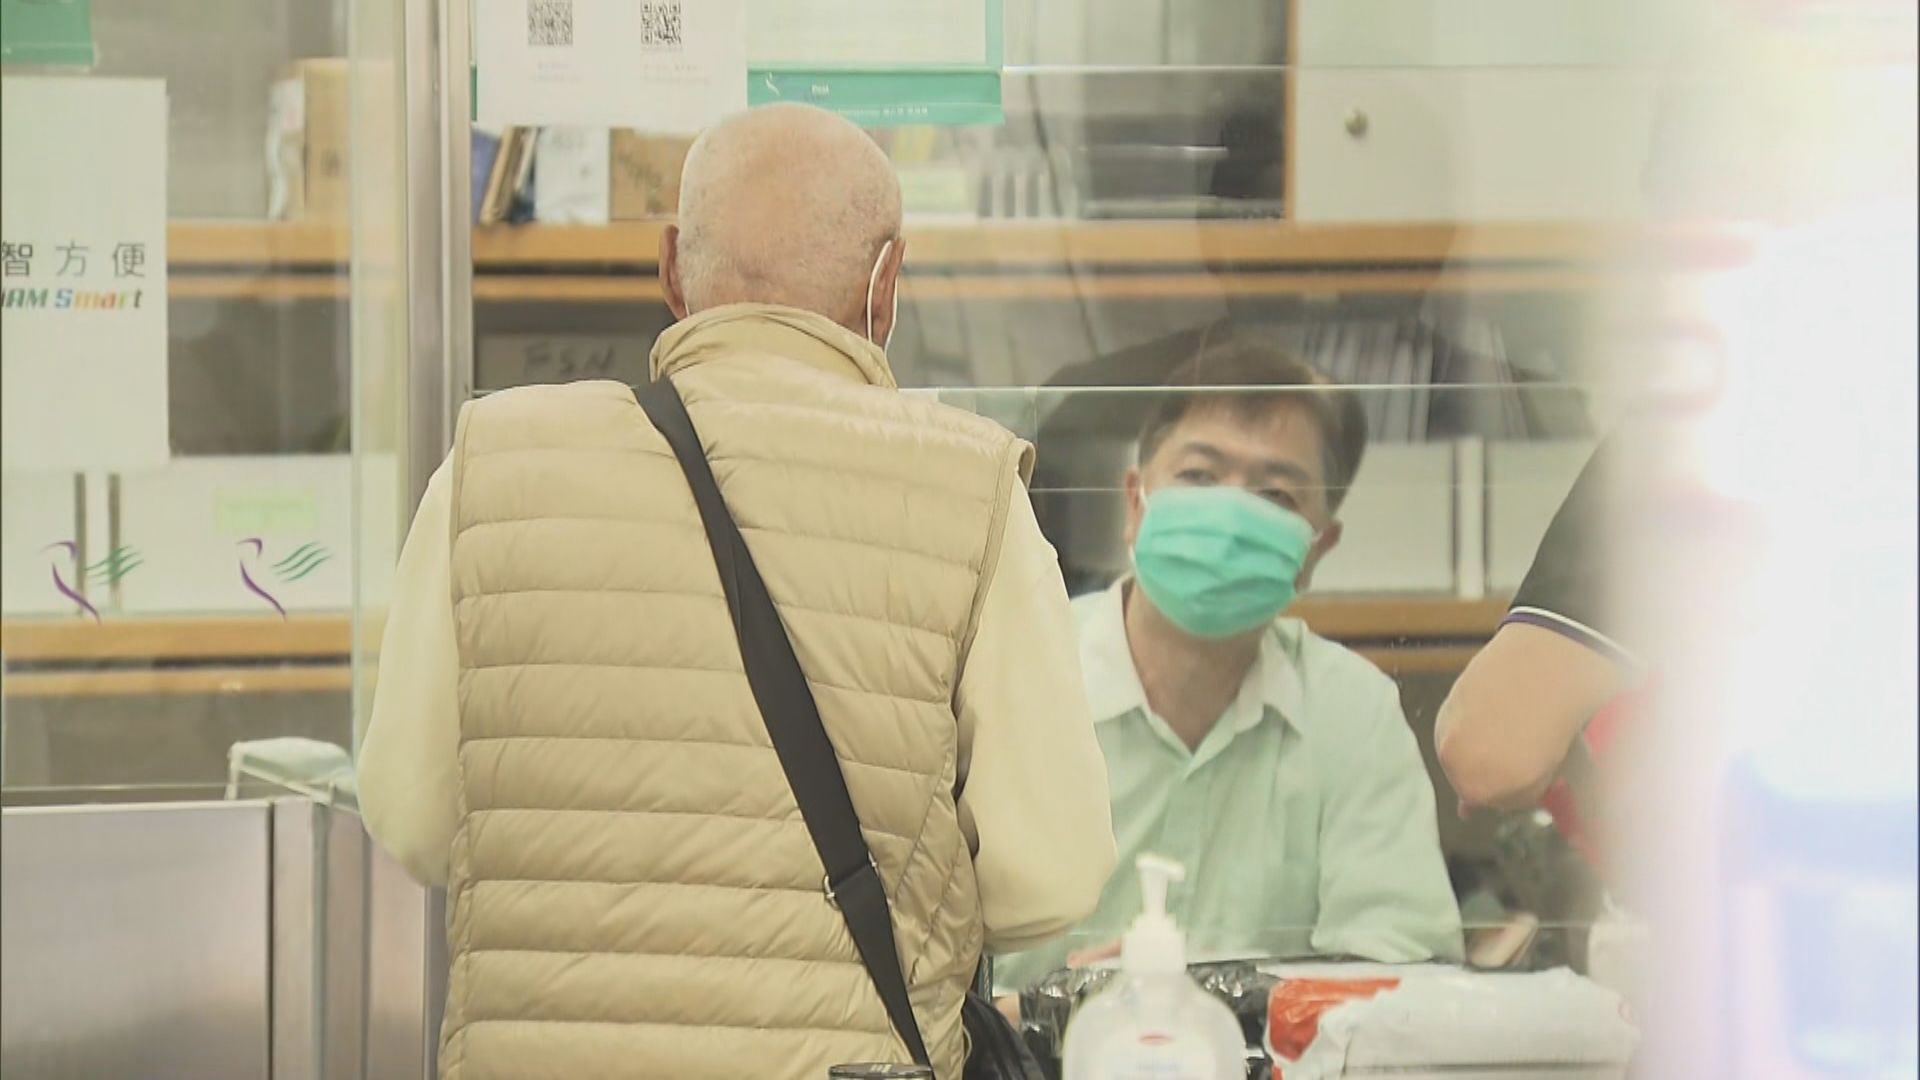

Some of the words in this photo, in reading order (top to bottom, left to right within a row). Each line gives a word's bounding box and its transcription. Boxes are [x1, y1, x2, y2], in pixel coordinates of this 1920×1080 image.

[1, 240, 146, 277] 智方便
[55, 288, 143, 309] Smart
